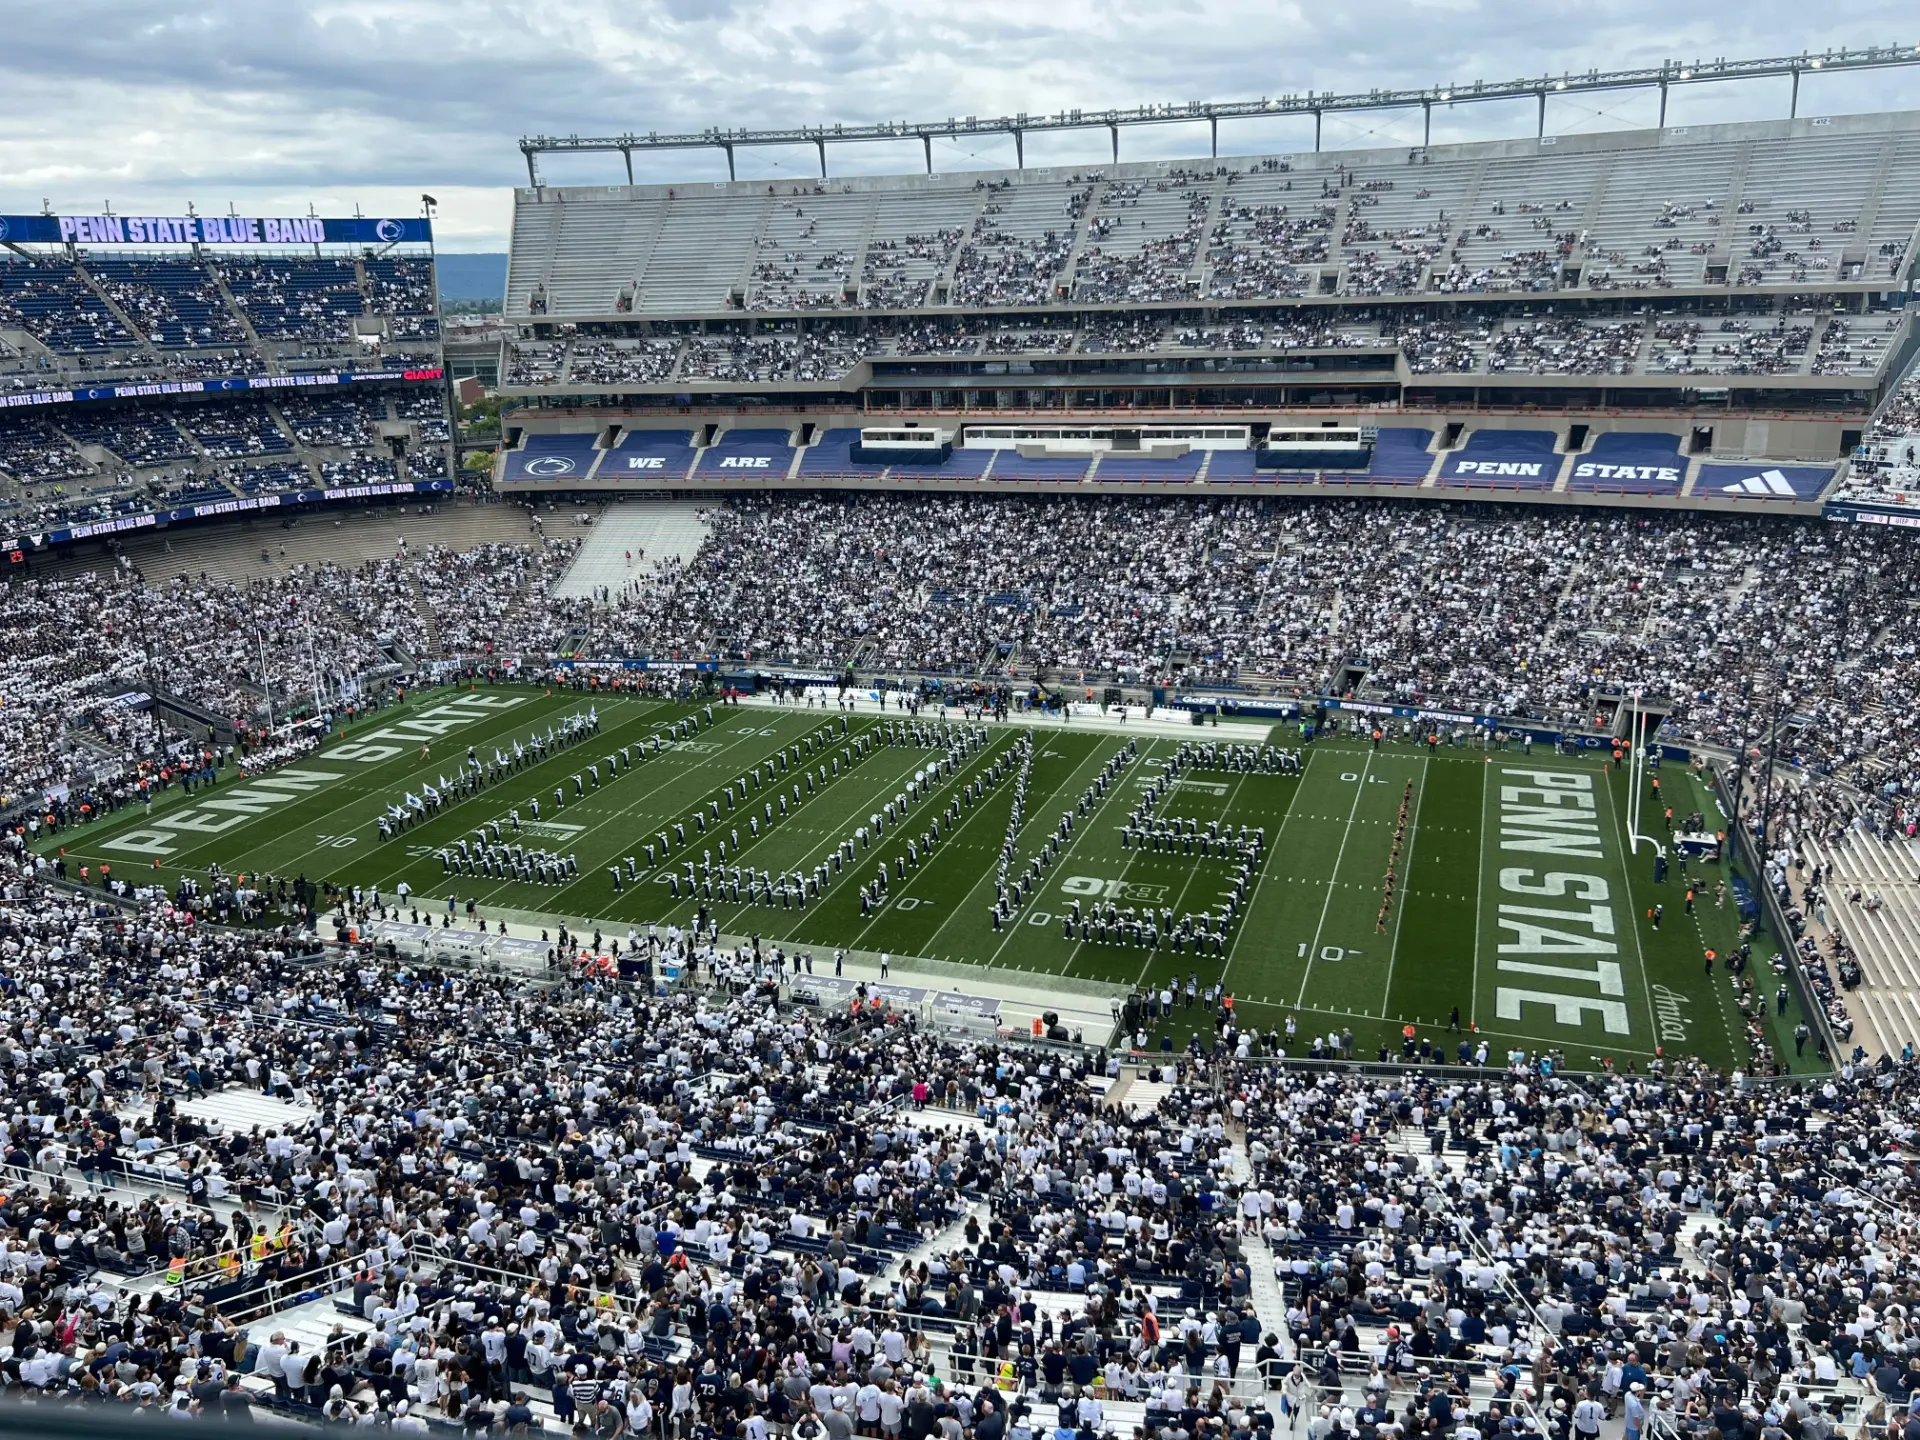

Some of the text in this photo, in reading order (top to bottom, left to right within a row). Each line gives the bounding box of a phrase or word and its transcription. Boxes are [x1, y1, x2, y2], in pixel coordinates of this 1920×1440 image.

[58, 216, 325, 243] PENN STATE BLUE BAND
[249, 374, 338, 388] PENN STATE BLUE BAND
[404, 370, 443, 380] GIANT
[114, 382, 204, 397] PENN STATE BLUE BAND
[8, 394, 32, 406] STATE
[33, 393, 52, 404] BLUE
[52, 392, 73, 402] BAND
[629, 457, 666, 468] WE
[720, 456, 772, 468] ARE
[1456, 461, 1542, 476] PENN
[1574, 462, 1680, 482] STATE
[324, 482, 414, 500] PENN STATE BLUE BAND
[194, 496, 280, 516] PENN STATE BLUE BAND
[1827, 514, 1849, 522] Gemini
[71, 515, 155, 538] PENN STATE BLUE BAND
[2, 540, 18, 548] BUF
[11, 551, 24, 562] 25
[101, 694, 528, 855] PENN STATE
[1496, 768, 1630, 1034] PENN STATE
[1297, 943, 1344, 962] 10
[1652, 984, 1690, 1041] Amica
[115, 1070, 124, 1079] 39
[985, 1114, 991, 1123] 11
[192, 1182, 203, 1193] 99
[578, 1212, 586, 1223] 31
[1451, 1226, 1456, 1236] 5
[714, 1242, 719, 1252] 1
[489, 1340, 493, 1350] 1
[802, 1339, 808, 1349] 1
[528, 1352, 536, 1366] 17
[616, 1389, 623, 1400] 6
[701, 1384, 715, 1395] 73
[1589, 1406, 1593, 1419] 1
[750, 1427, 756, 1439] 1
